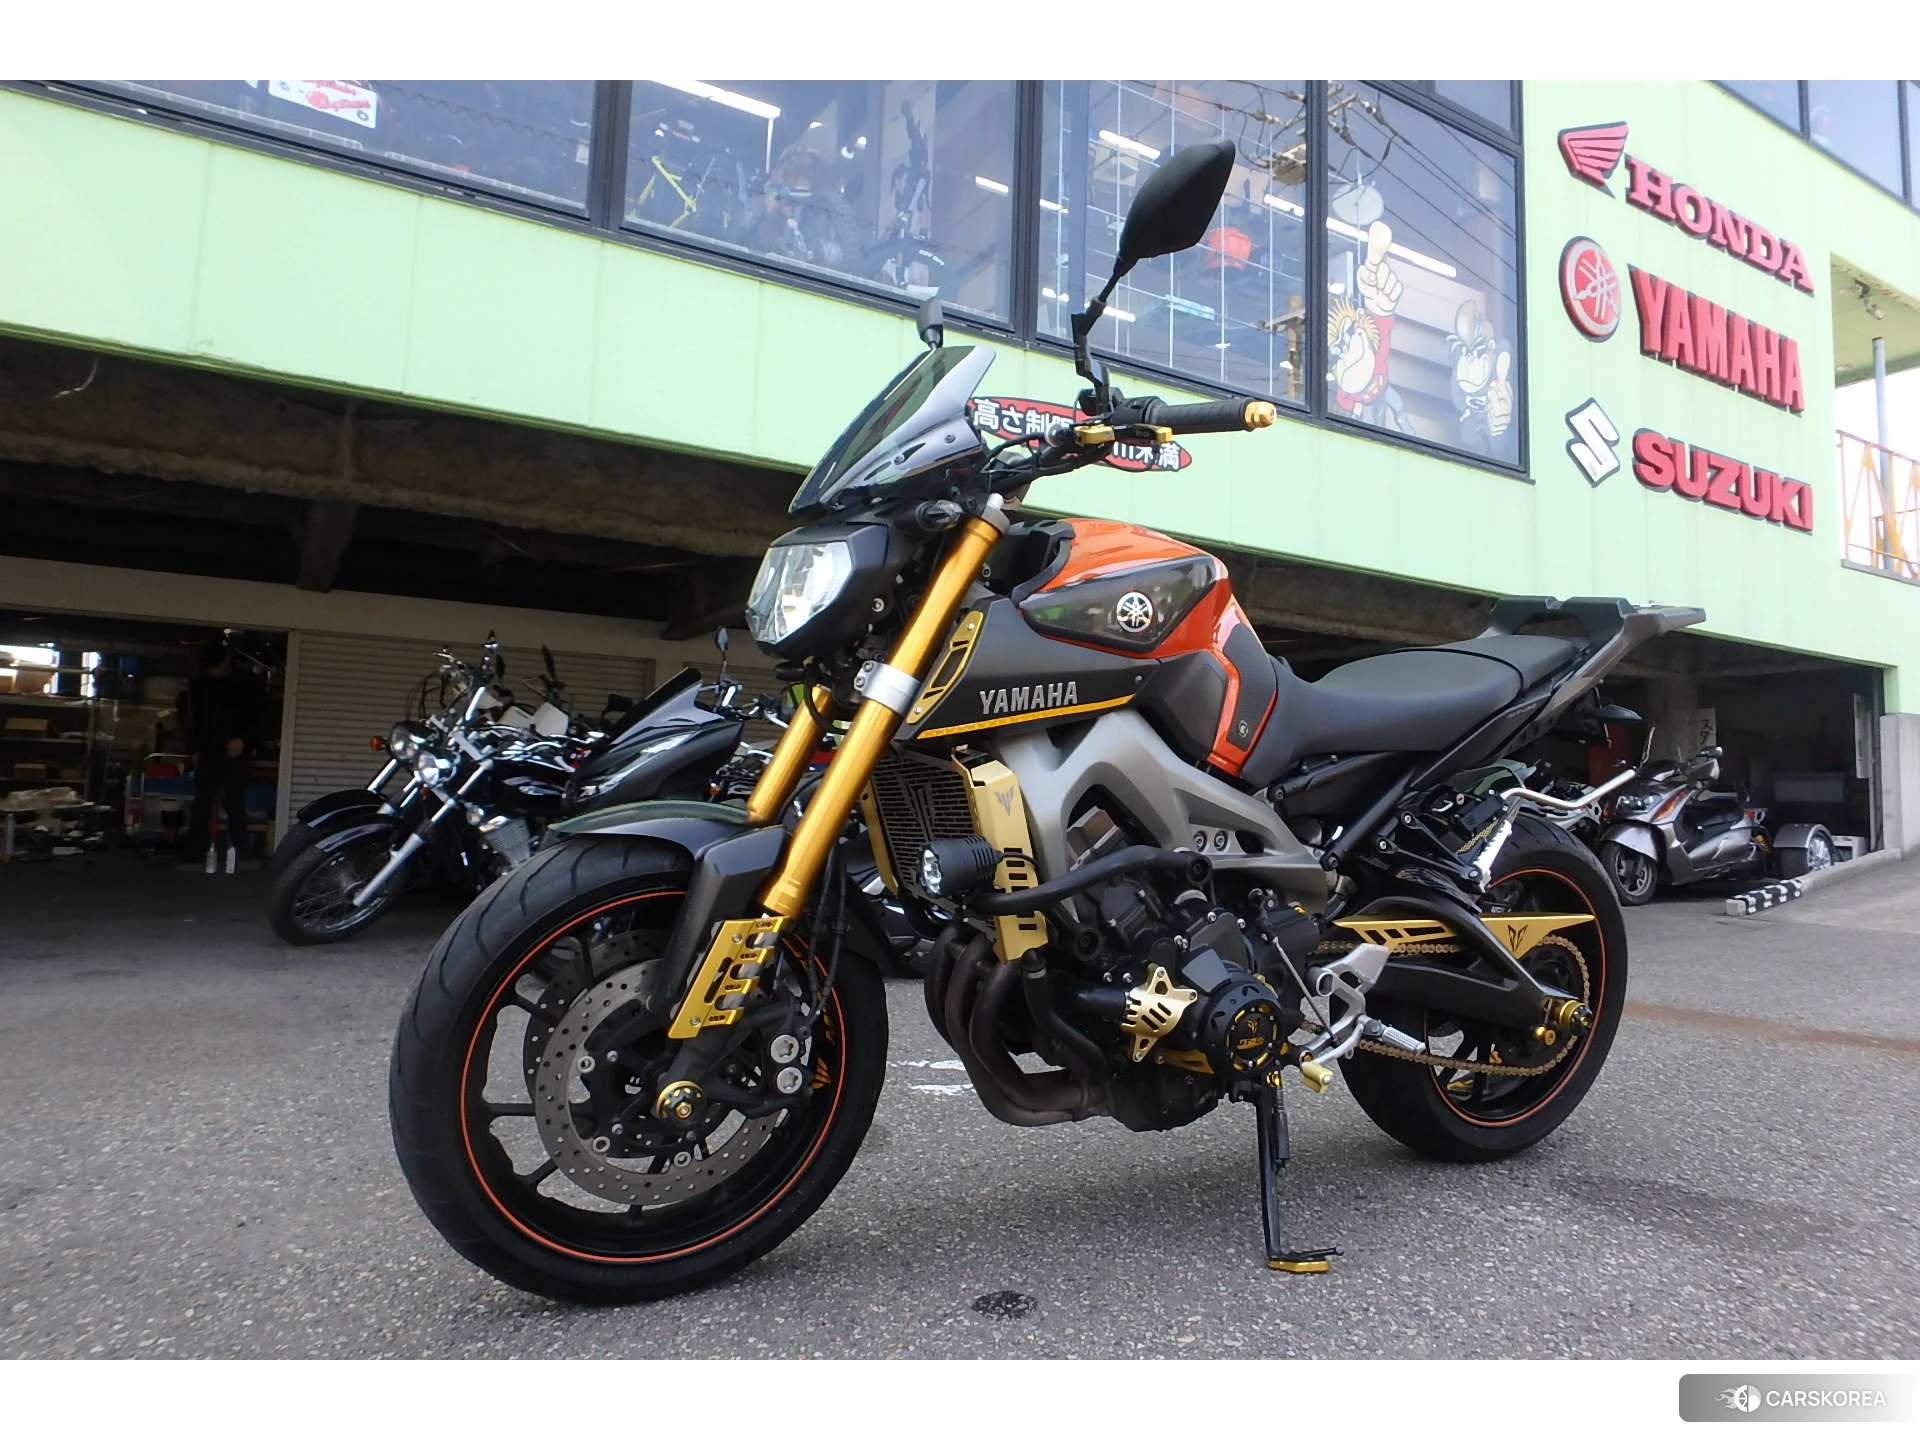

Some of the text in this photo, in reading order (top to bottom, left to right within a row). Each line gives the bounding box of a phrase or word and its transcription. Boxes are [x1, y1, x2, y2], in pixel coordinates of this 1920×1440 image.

[1625, 155, 1814, 297] HONDA
[1628, 264, 1805, 416] YAMAHA
[1633, 428, 1814, 535] SUZUKI
[980, 681, 1078, 715] YAMAHA
